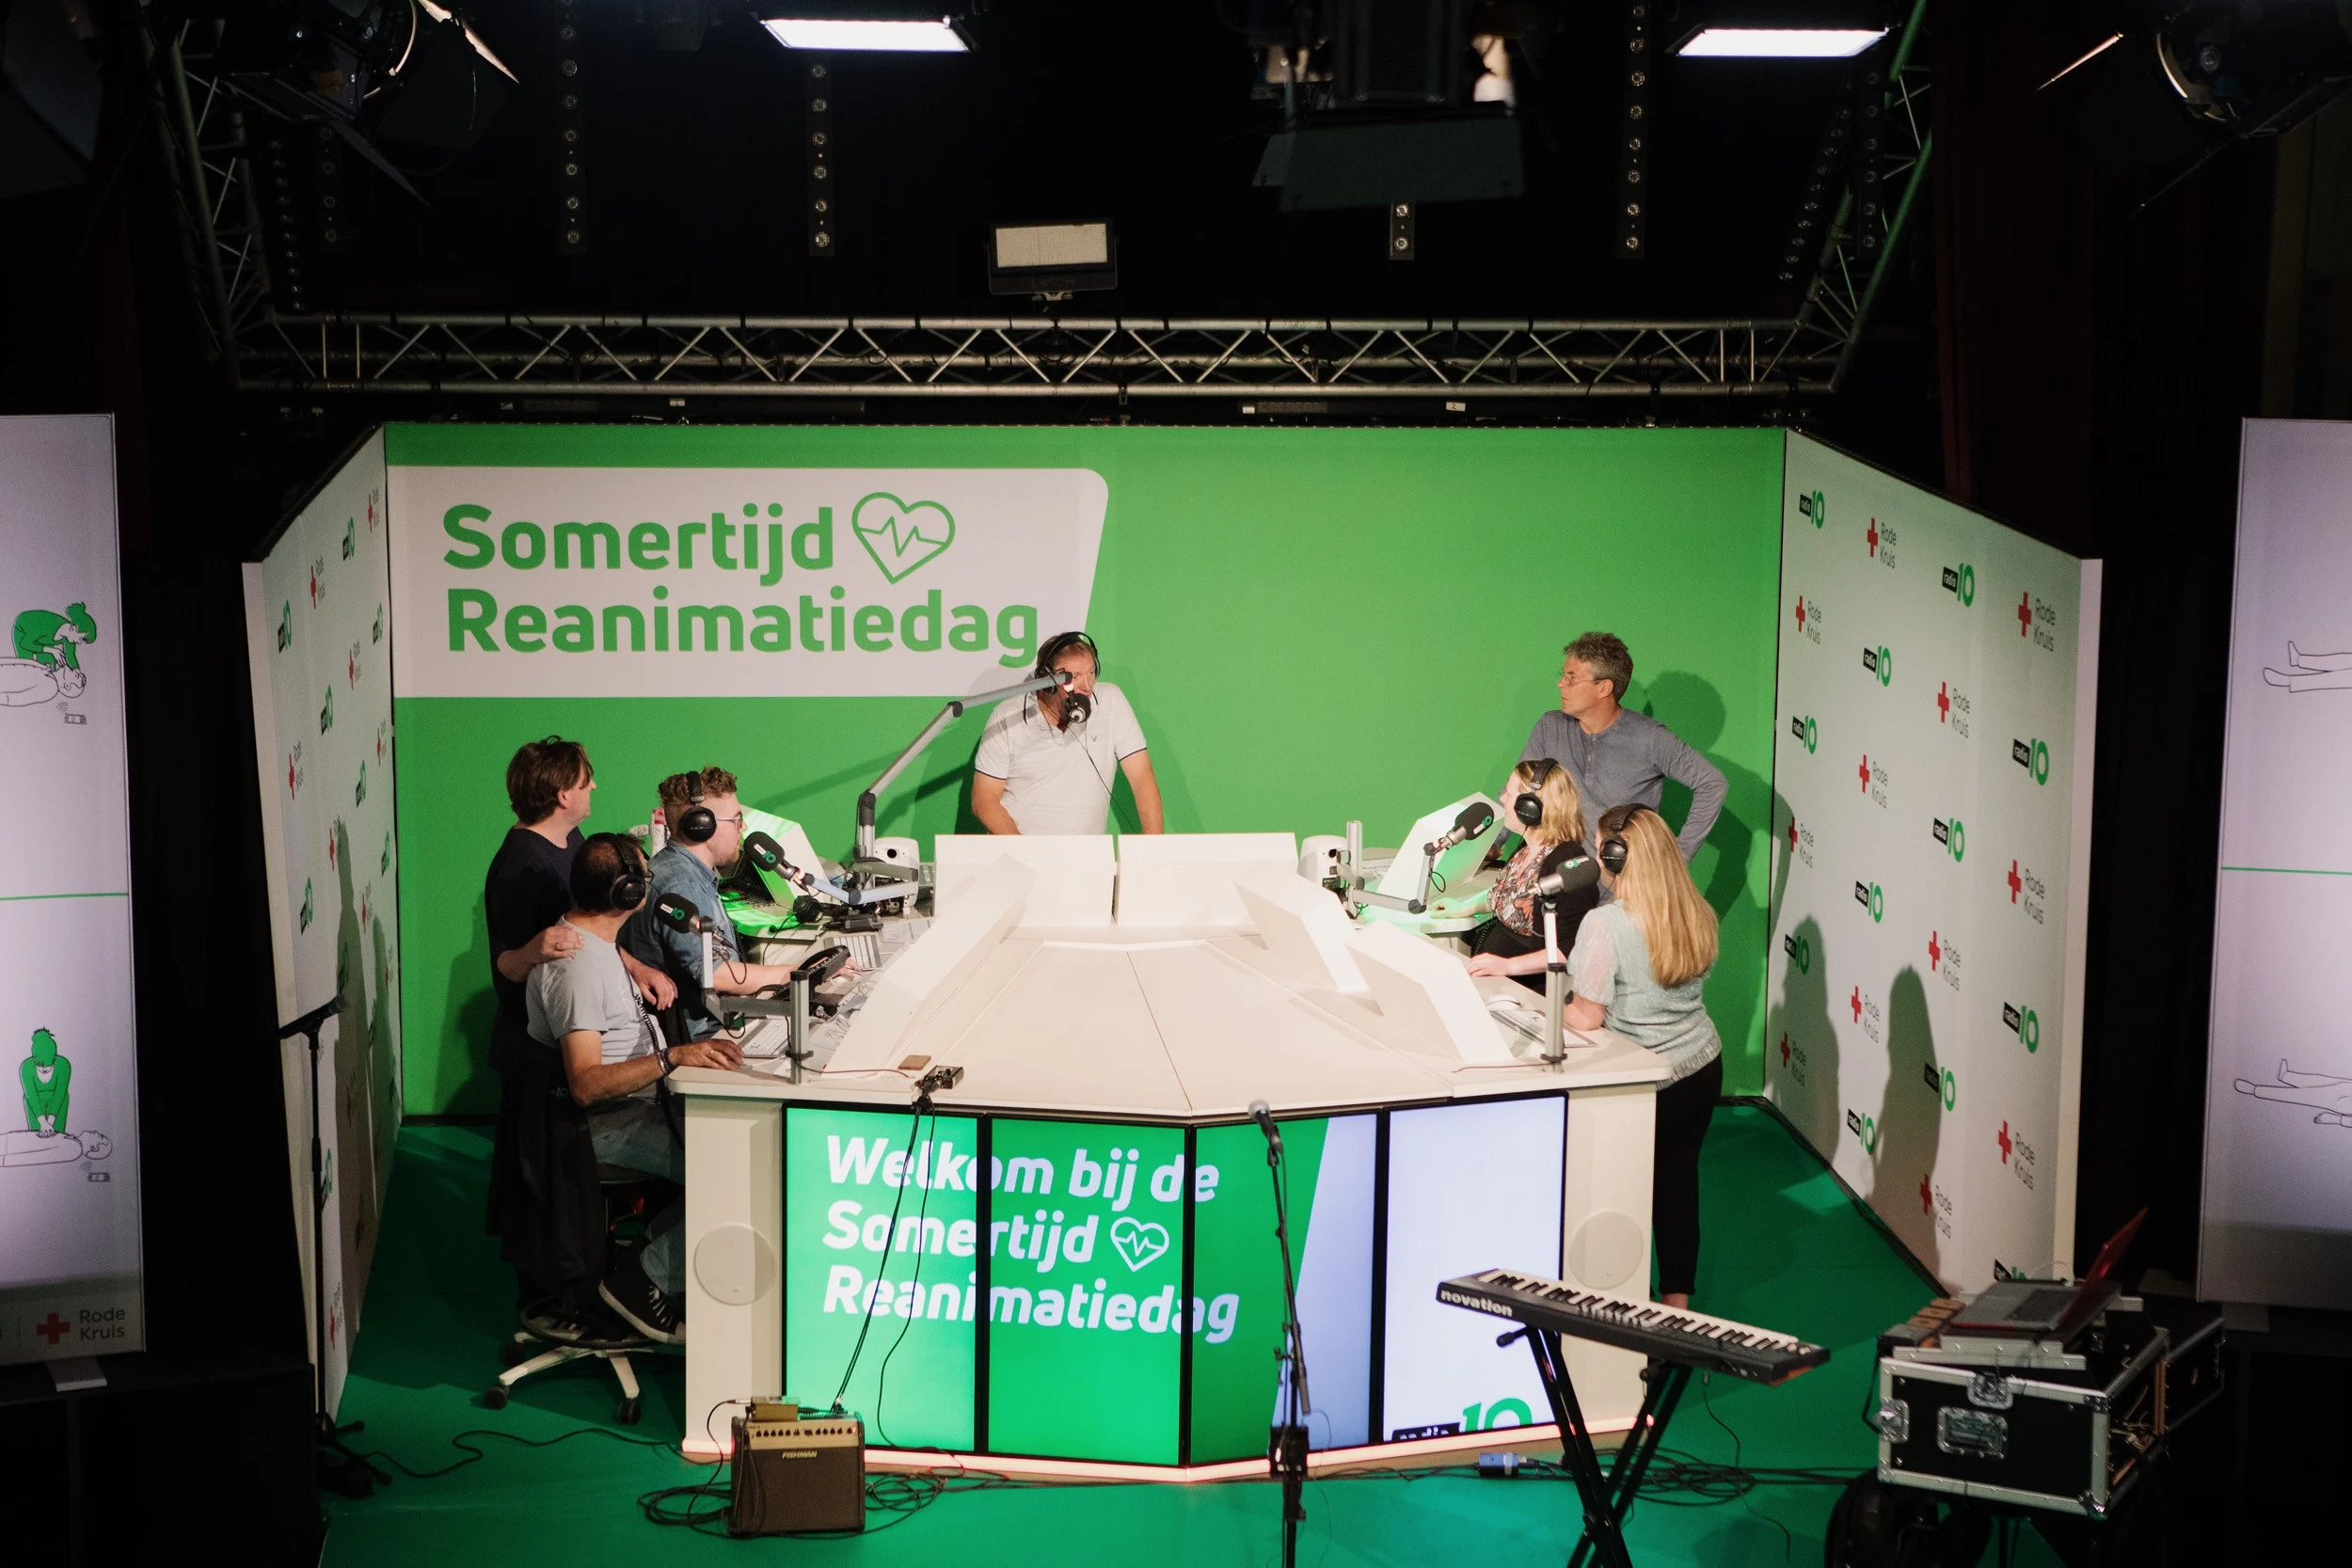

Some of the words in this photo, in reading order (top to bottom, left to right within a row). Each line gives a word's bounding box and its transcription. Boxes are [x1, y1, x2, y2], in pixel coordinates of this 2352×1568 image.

[442, 501, 834, 587] Somertijd
[1882, 522, 1897, 546] Rode
[1880, 546, 1895, 569] Kruis
[1957, 562, 1975, 608] 10
[1807, 600, 1821, 623] Rode
[2035, 598, 2056, 626] Rode
[447, 585, 1038, 668] Reanimatiedag
[2033, 625, 2053, 652] Kruis
[1952, 688, 1970, 714] Rode
[1951, 712, 1969, 738] Kruis
[2029, 737, 2049, 786] 10
[827, 1134, 1054, 1196] Welkom
[1068, 1147, 1140, 1212] bij
[1150, 1153, 1220, 1202] de
[822, 1199, 1099, 1274] Somertijd
[80, 1307, 125, 1324] Rode
[823, 1264, 1240, 1344] Reanimatiedag
[1440, 1290, 1513, 1317] novation
[80, 1324, 125, 1341] Kruis
[782, 1450, 818, 1460] FISHMAN
